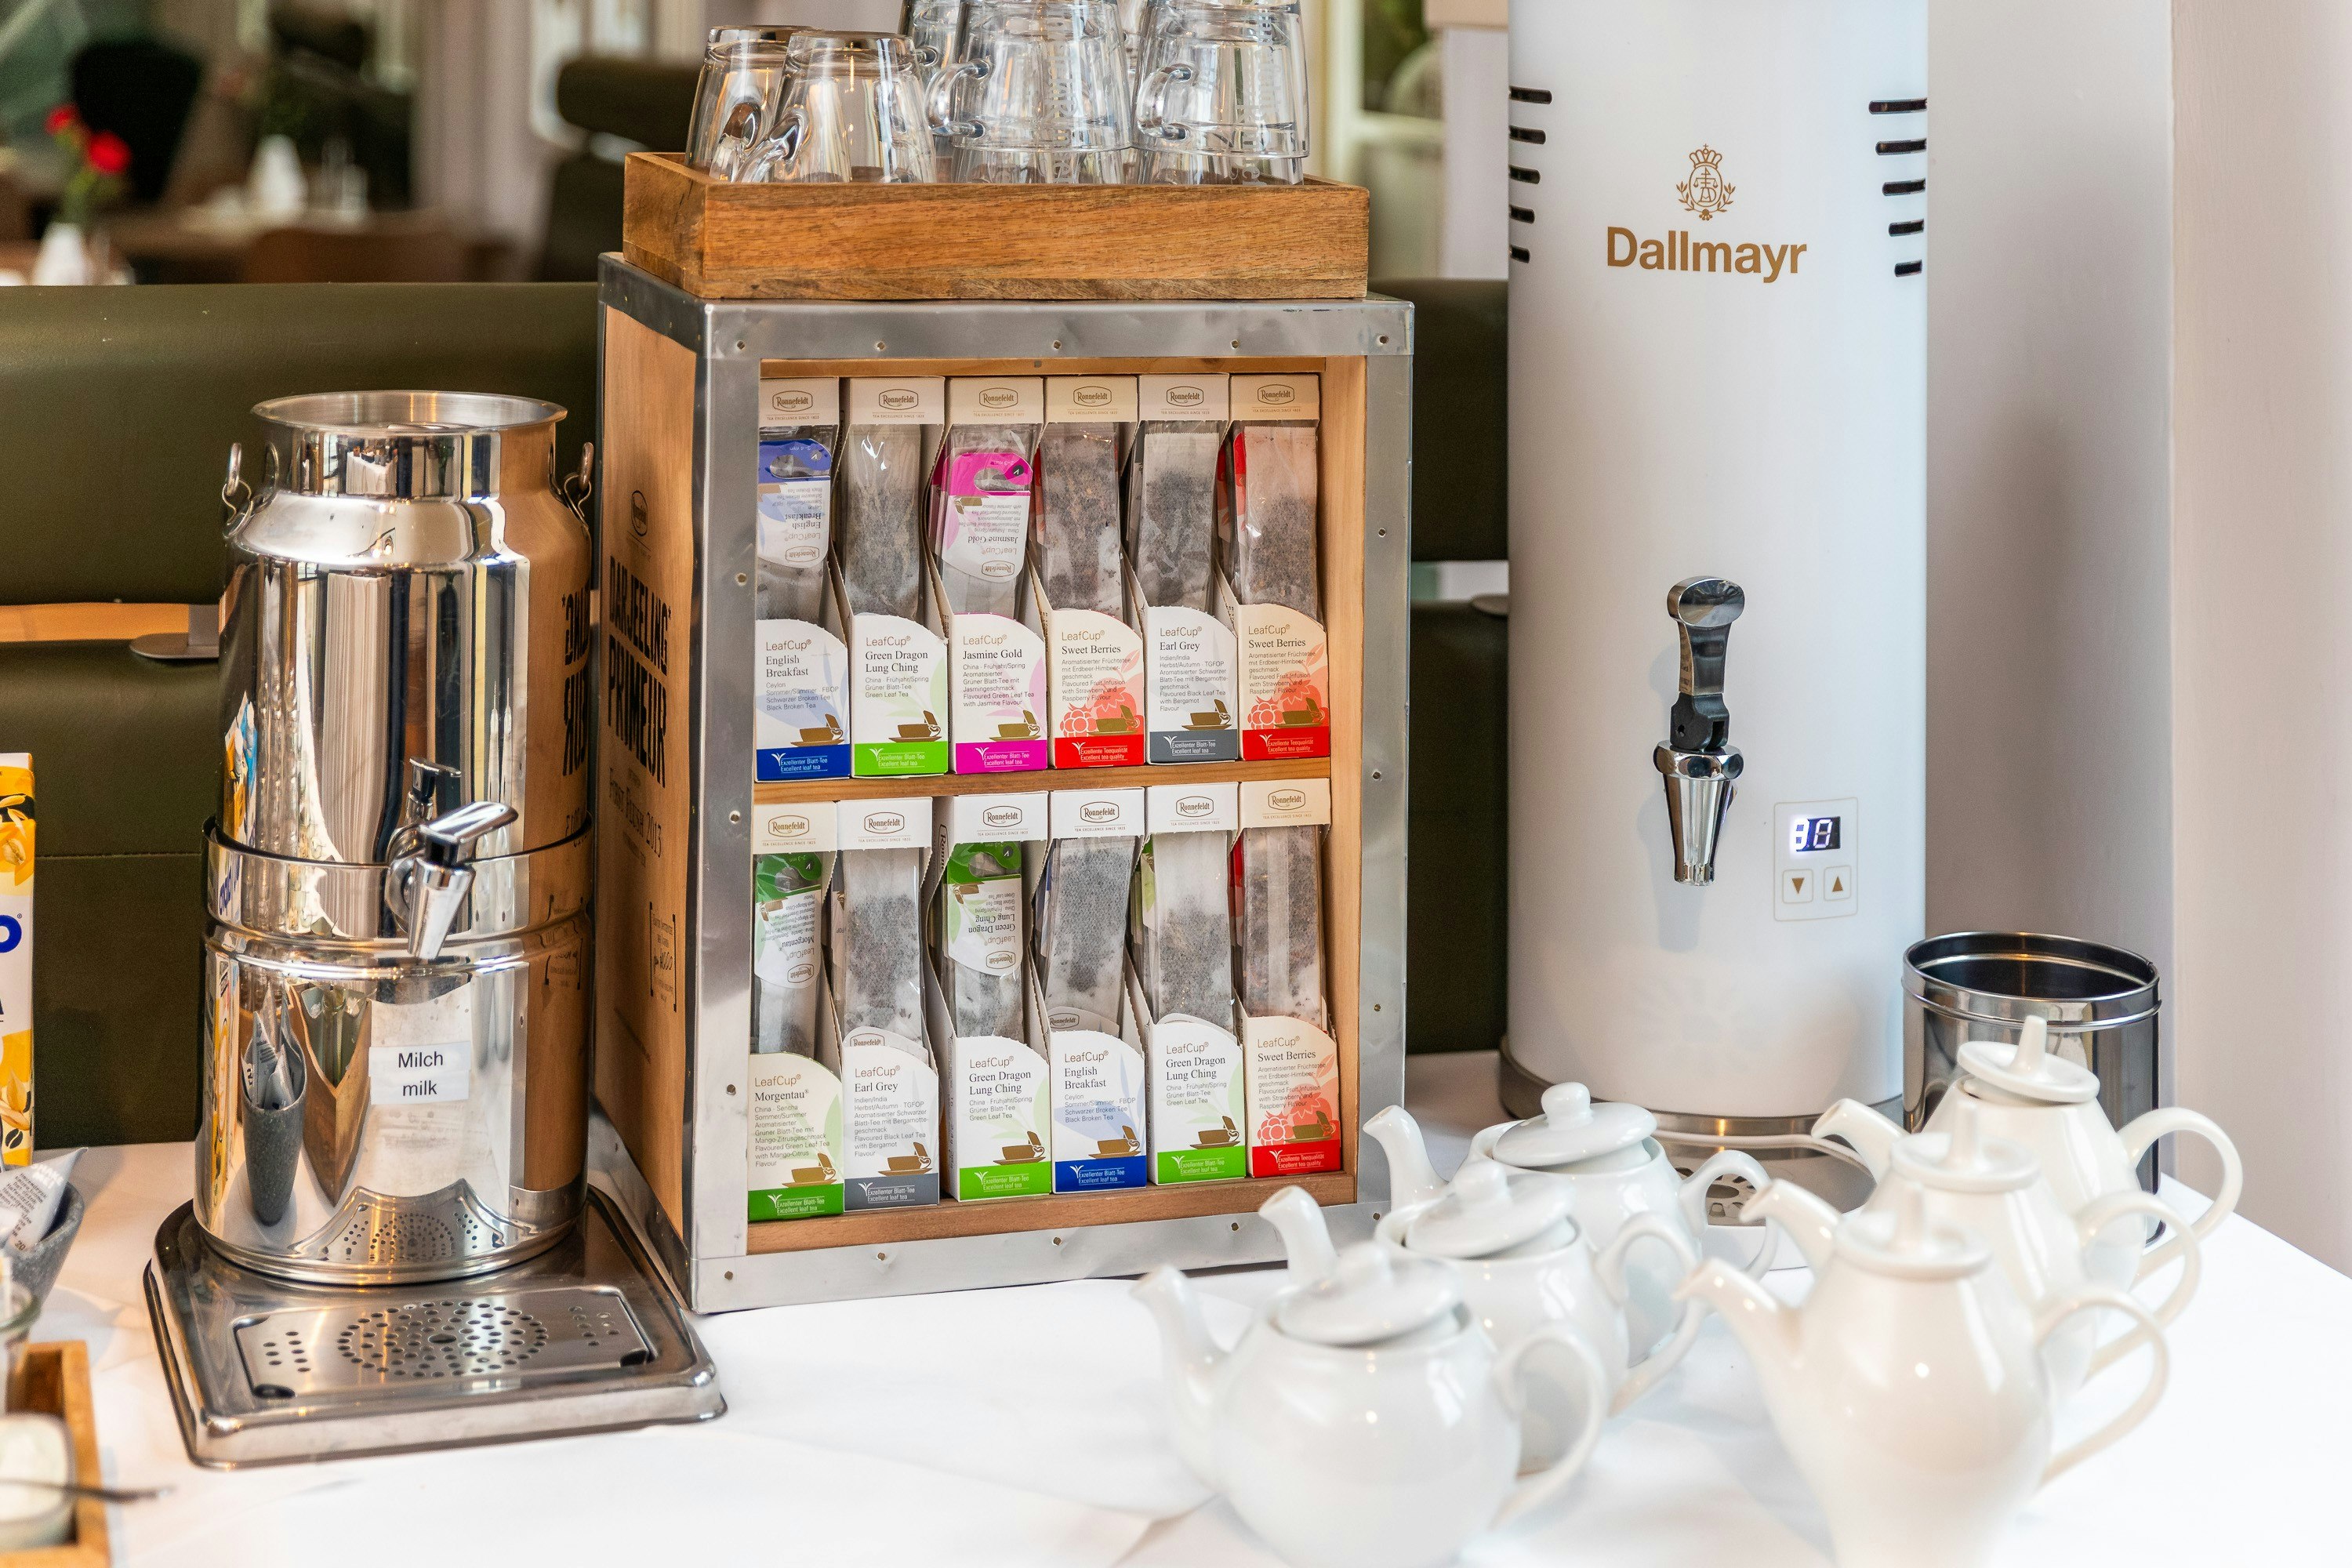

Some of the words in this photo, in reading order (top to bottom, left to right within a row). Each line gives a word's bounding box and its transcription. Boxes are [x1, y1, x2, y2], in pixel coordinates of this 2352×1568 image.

[1607, 226, 1806, 283] Dallmayr
[983, 394, 1014, 403] Ronnefeldt
[1077, 392, 1108, 401] Ronnefeldt
[1261, 390, 1291, 398] Ronnefeldt
[776, 396, 808, 406] Ronnefeldt
[883, 395, 914, 404] Ronnefeldt
[1179, 642, 1200, 652] Grey
[1249, 640, 1273, 648] Sweet
[964, 651, 998, 659] Jasmine
[1062, 646, 1087, 655] Sweet
[766, 655, 800, 666] English
[895, 651, 928, 661] Dragon
[766, 668, 808, 677] Breakfast
[866, 664, 888, 674] Lung
[891, 664, 918, 673] Ching
[608, 634, 666, 789] PRIMEUR
[1272, 795, 1301, 804] Ronnefeldt
[1180, 802, 1210, 811] Ronnefeldt
[987, 812, 1018, 822] Ronnefeldt
[1084, 807, 1116, 817] Ronnefeldt
[772, 822, 805, 832] Ronnefeldt
[868, 818, 901, 828] Ronnefeldt
[647, 811, 661, 858] 2013
[790, 967, 811, 979] Ronnefeldt
[398, 1051, 443, 1068] Milch
[1258, 1053, 1283, 1062] Sweet
[1287, 1051, 1316, 1060] Berries
[1167, 1058, 1192, 1068] Green
[1194, 1057, 1225, 1067] Dragon
[970, 1073, 996, 1082] Green
[999, 1072, 1031, 1082] Dragon
[1065, 1067, 1098, 1077] English
[1167, 1072, 1189, 1082] Lung
[1191, 1070, 1217, 1080] Ching
[403, 1080, 437, 1096] milk
[855, 1083, 873, 1092] Earl
[876, 1083, 898, 1092] Grey
[1065, 1080, 1106, 1089] Breakfast
[970, 1087, 993, 1097] Lung
[996, 1084, 1022, 1095] Ching
